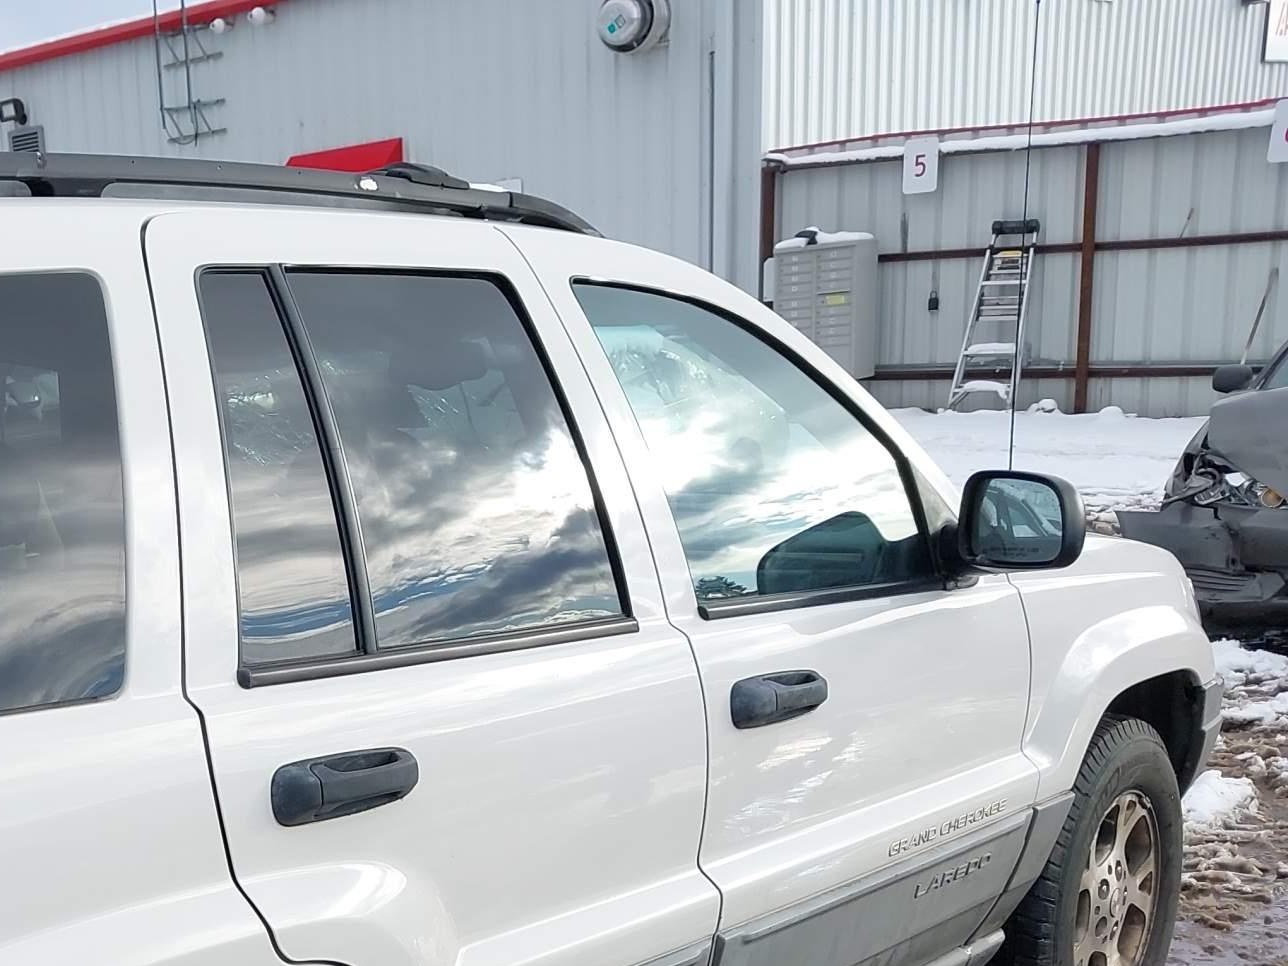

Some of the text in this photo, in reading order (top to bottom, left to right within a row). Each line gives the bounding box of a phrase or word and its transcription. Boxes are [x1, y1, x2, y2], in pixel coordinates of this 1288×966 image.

[914, 153, 927, 178] 5
[888, 799, 1008, 857] GRAND CHEROKEE
[913, 852, 993, 899] LAREDO
